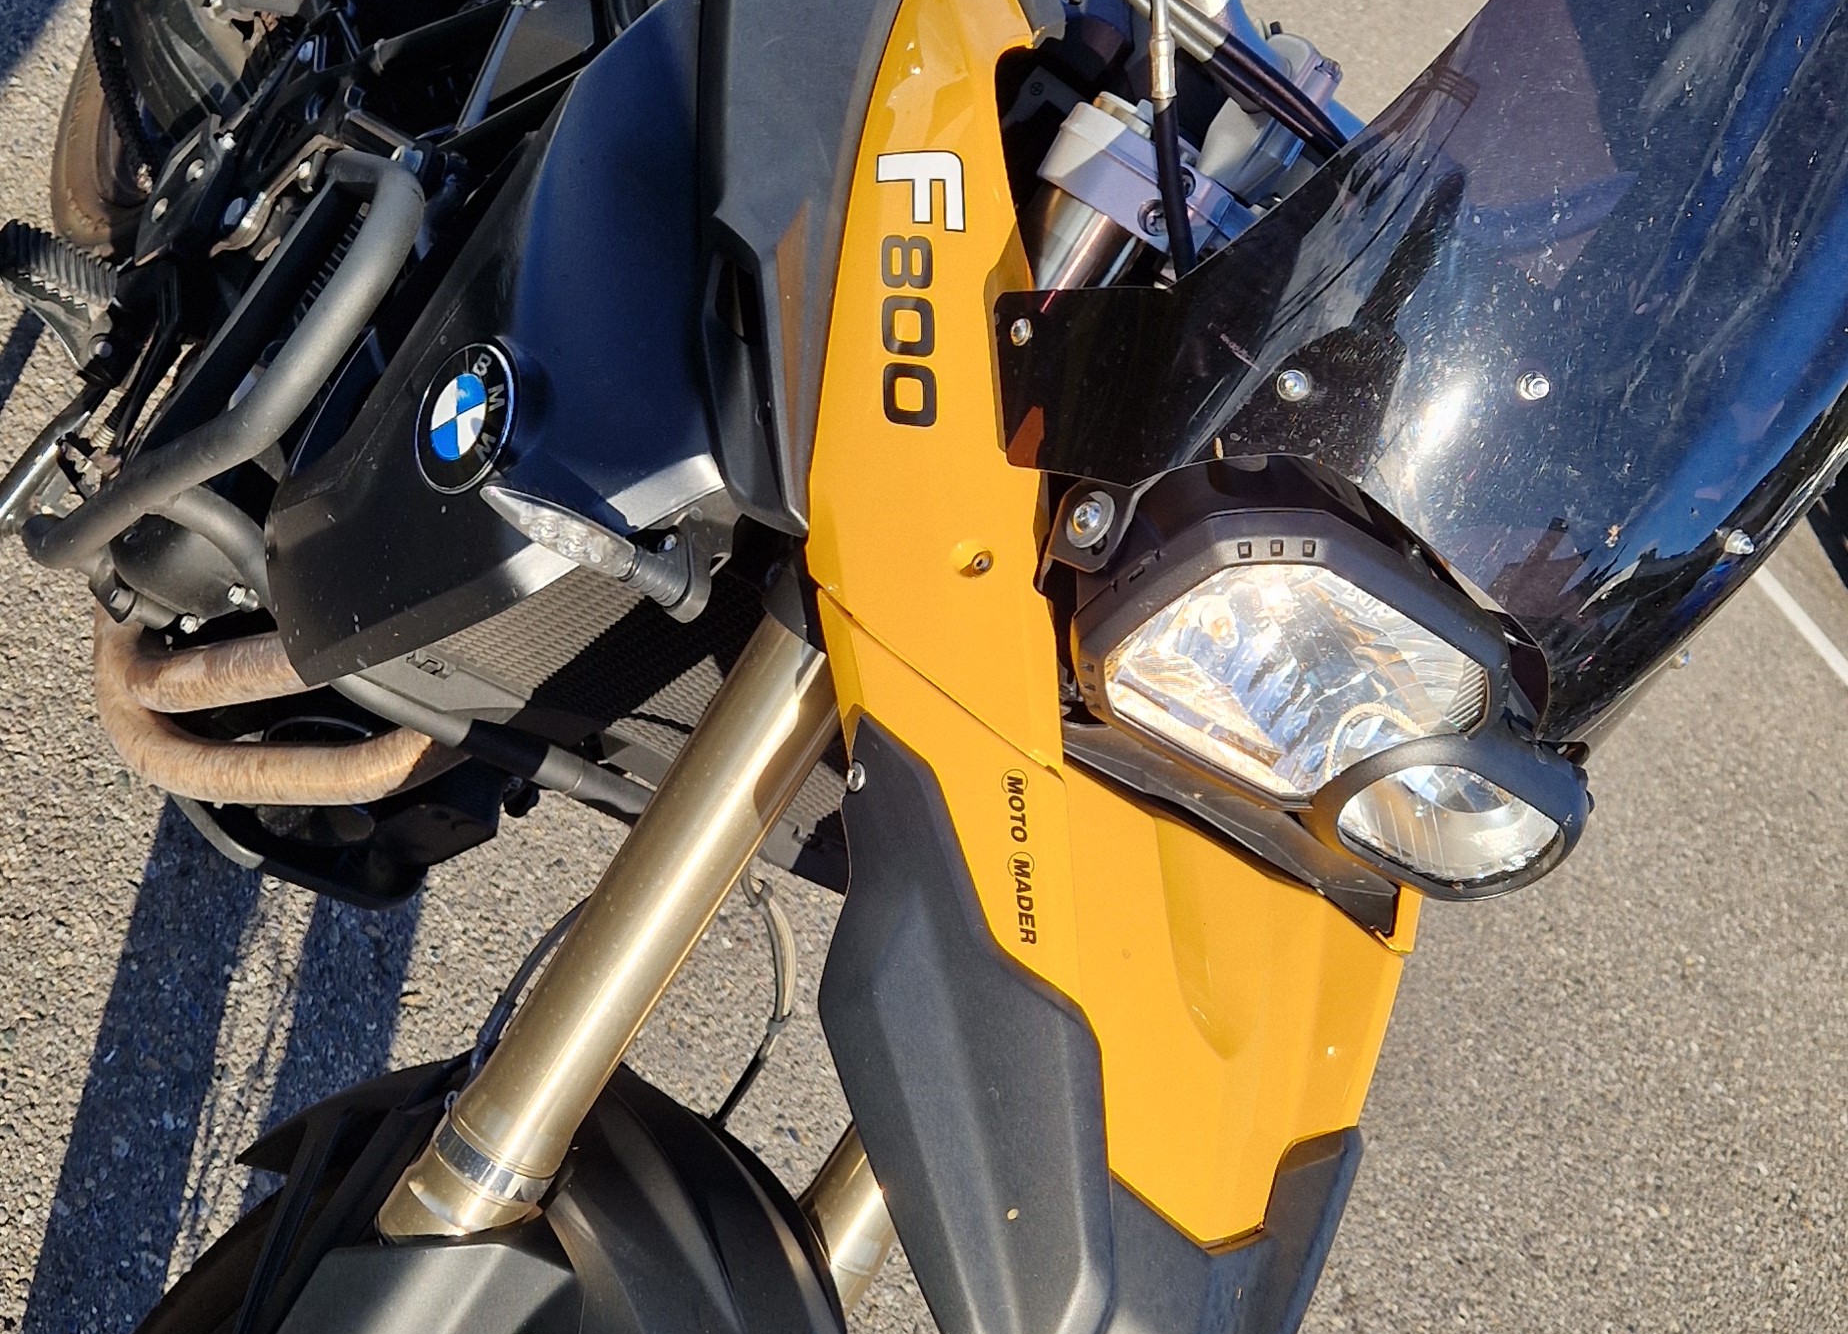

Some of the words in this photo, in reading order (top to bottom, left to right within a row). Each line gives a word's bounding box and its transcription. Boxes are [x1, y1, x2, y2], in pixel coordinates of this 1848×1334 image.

[472, 352, 505, 463] BMW
[1003, 771, 1028, 843] MOTO
[1010, 854, 1037, 945] MADER
